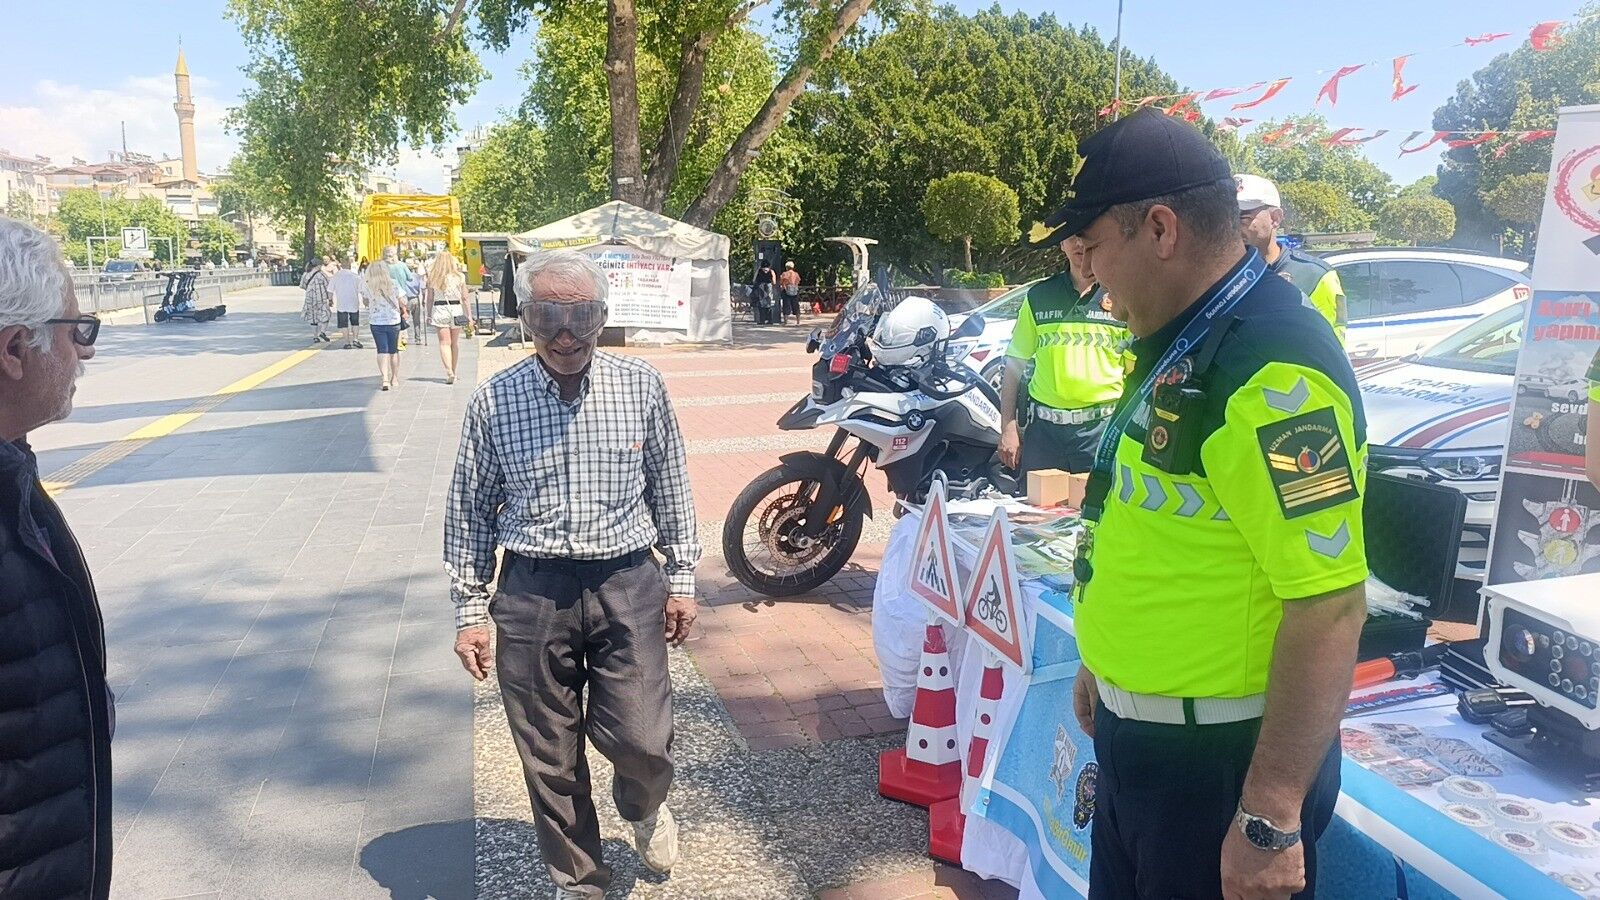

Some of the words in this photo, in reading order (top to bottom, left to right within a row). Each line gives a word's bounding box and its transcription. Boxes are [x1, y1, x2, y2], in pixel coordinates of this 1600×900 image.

[1225, 277, 1248, 300] european
[1205, 298, 1227, 319] rowing
[1551, 402, 1588, 415] sevd
[895, 437, 906, 445] 112
[1269, 430, 1293, 452] UZMAN
[1294, 423, 1333, 435] JANDARMA
